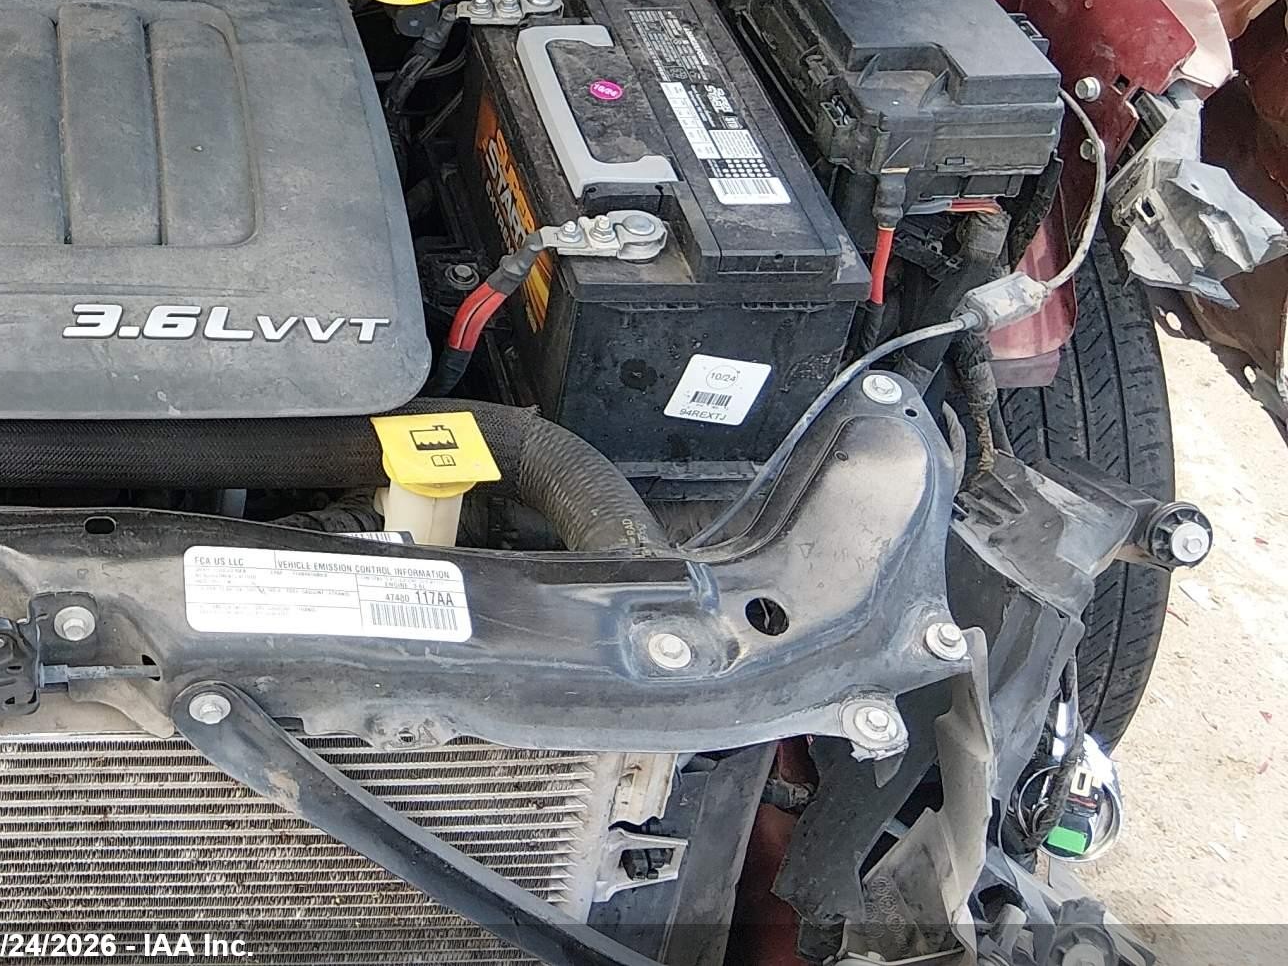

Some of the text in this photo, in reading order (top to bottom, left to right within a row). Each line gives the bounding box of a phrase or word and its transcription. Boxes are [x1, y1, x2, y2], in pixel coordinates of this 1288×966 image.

[496, 128, 536, 232] SUPER
[711, 372, 736, 382] 10/24
[679, 408, 727, 421] 94REXTJ
[194, 556, 245, 567] FCA US LLC
[277, 559, 450, 579] VEHICLE EMISSION CONTROL INFORMATION
[415, 590, 454, 606] 117AA
